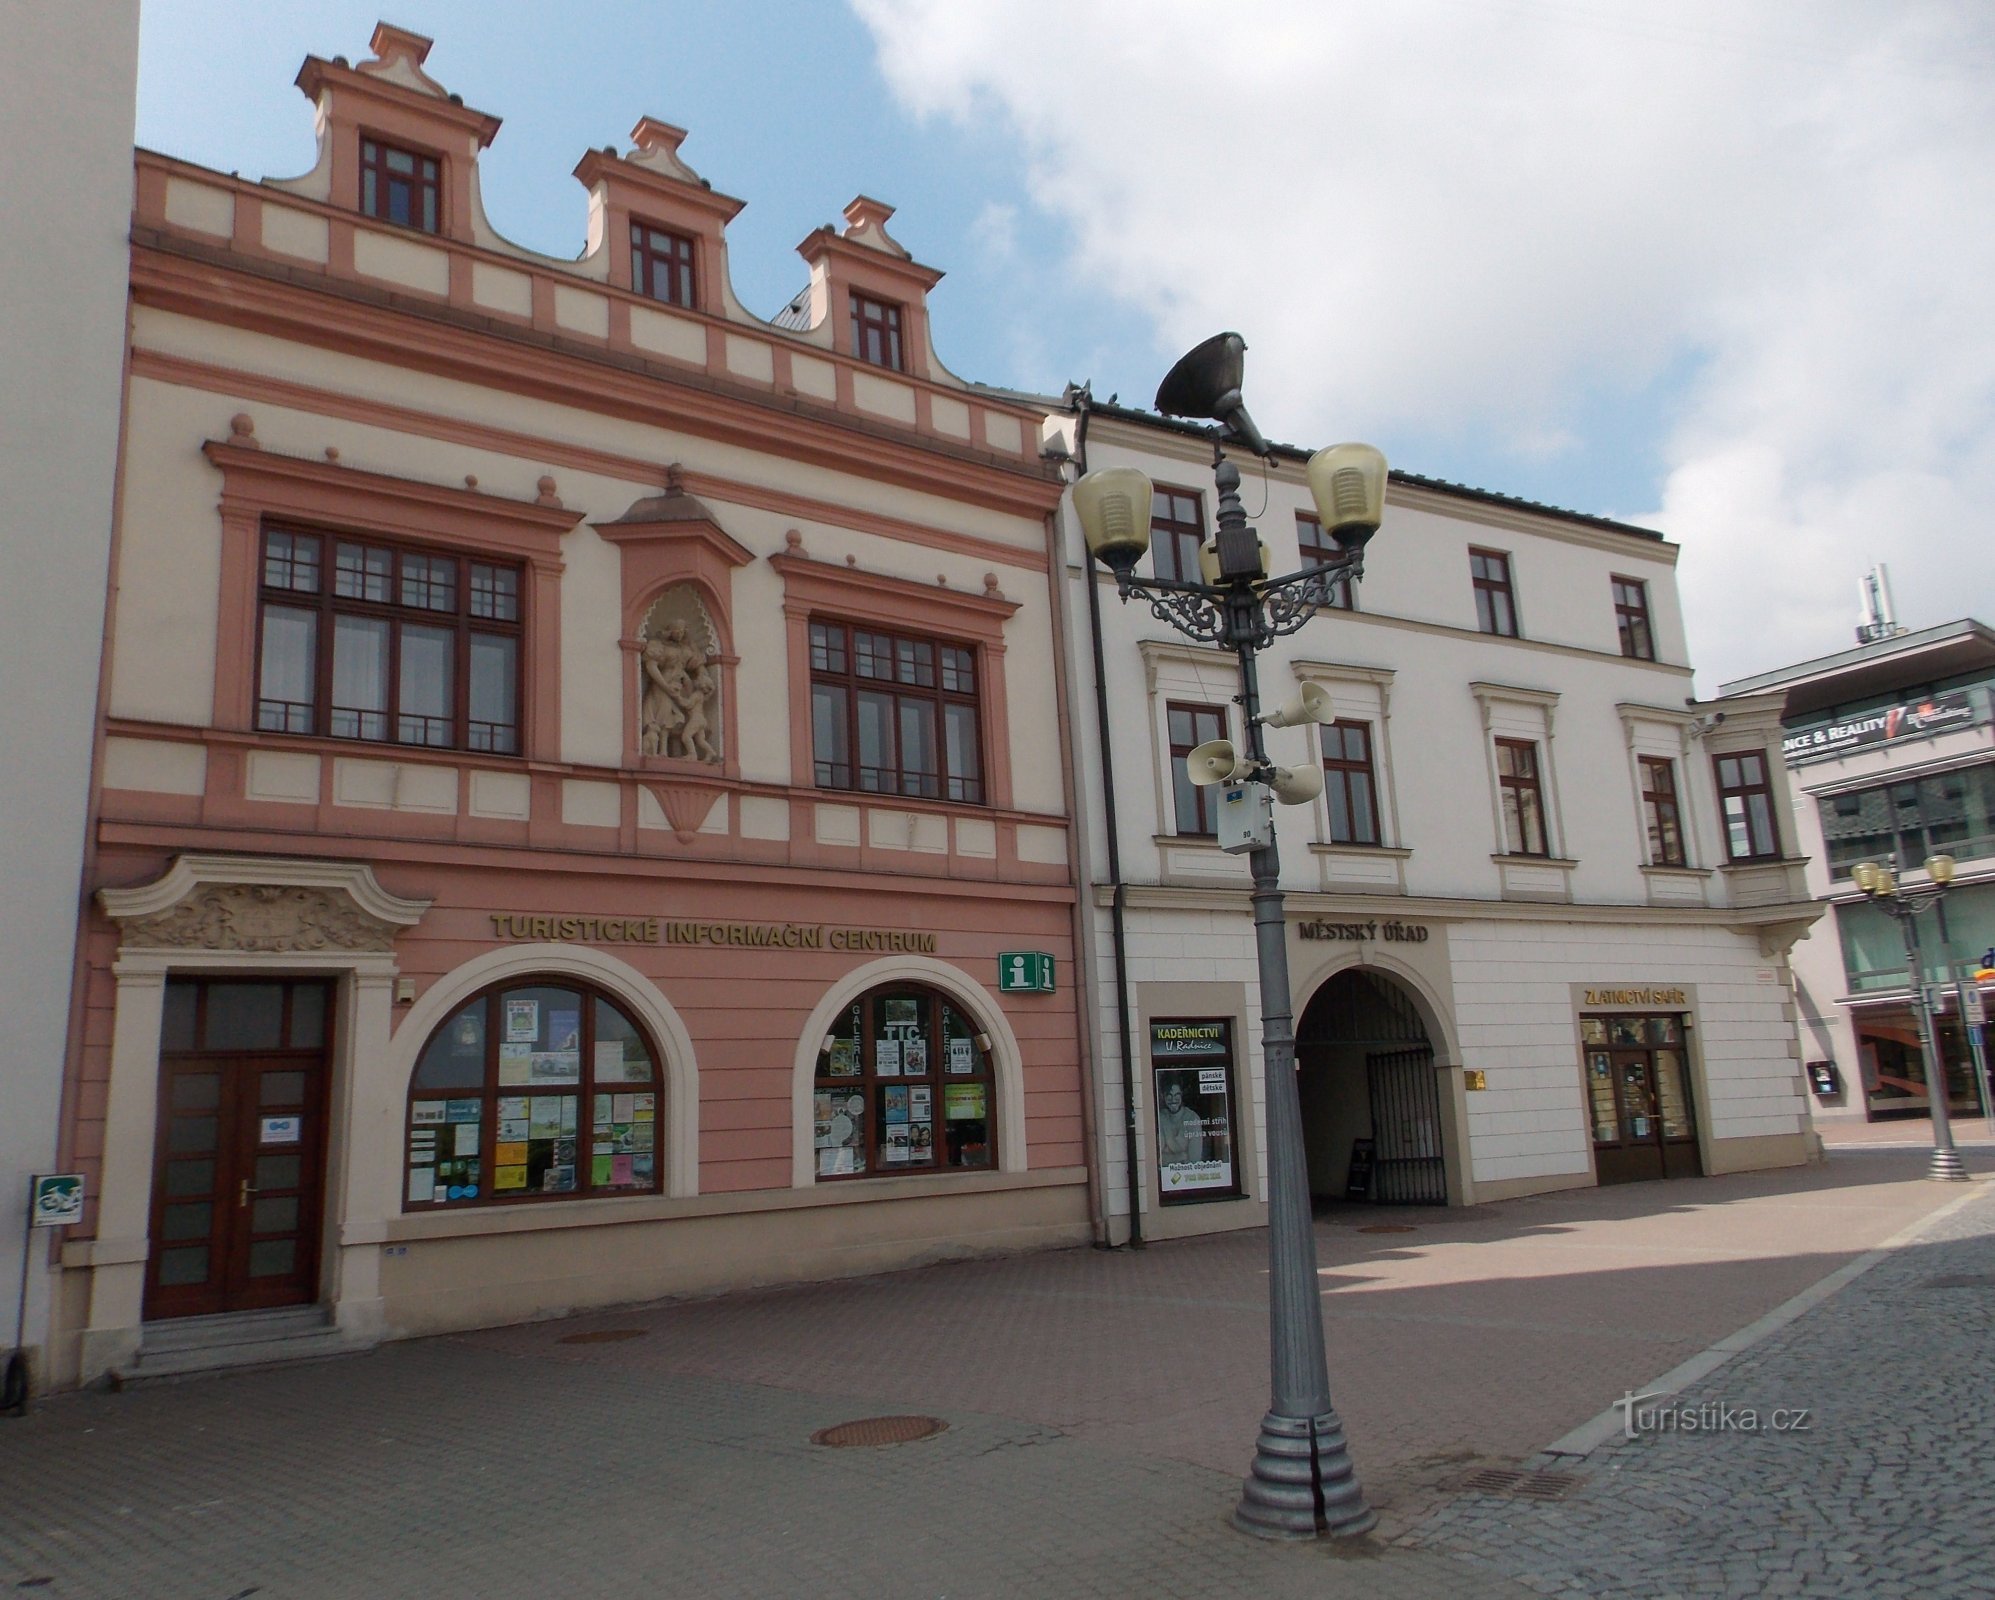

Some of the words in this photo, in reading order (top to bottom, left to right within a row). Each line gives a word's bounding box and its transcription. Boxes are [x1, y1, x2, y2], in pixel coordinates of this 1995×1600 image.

[1782, 734, 1812, 752] NCE
[1813, 730, 1827, 744] &
[1828, 716, 1887, 741] REALITY
[492, 914, 659, 943] TURISTICKÉ
[667, 922, 824, 949] INFORMAČNÍ
[829, 928, 937, 953] CENTRUM
[1299, 918, 1377, 940] MĚSTSKÝ
[1382, 920, 1428, 942] ÚŘAD
[1585, 987, 1650, 1005] ZLATNICTVÍ
[1653, 987, 1685, 1004] SAFÍR
[883, 1026, 920, 1041] TIC
[942, 1005, 951, 1073] GALERIE
[1157, 1026, 1218, 1039] KADEŘNICTVÍ
[852, 1005, 861, 1075] GALERIE
[1165, 1041, 1173, 1051] U
[1176, 1040, 1212, 1052] Radnice
[1201, 1071, 1222, 1080] pánské
[1201, 1083, 1223, 1092] dětské
[1184, 1117, 1210, 1126] moderní
[1211, 1116, 1227, 1125] střih
[1207, 1128, 1228, 1137] vousů
[1169, 1163, 1193, 1172] Možnost
[1193, 1161, 1222, 1171] objednání
